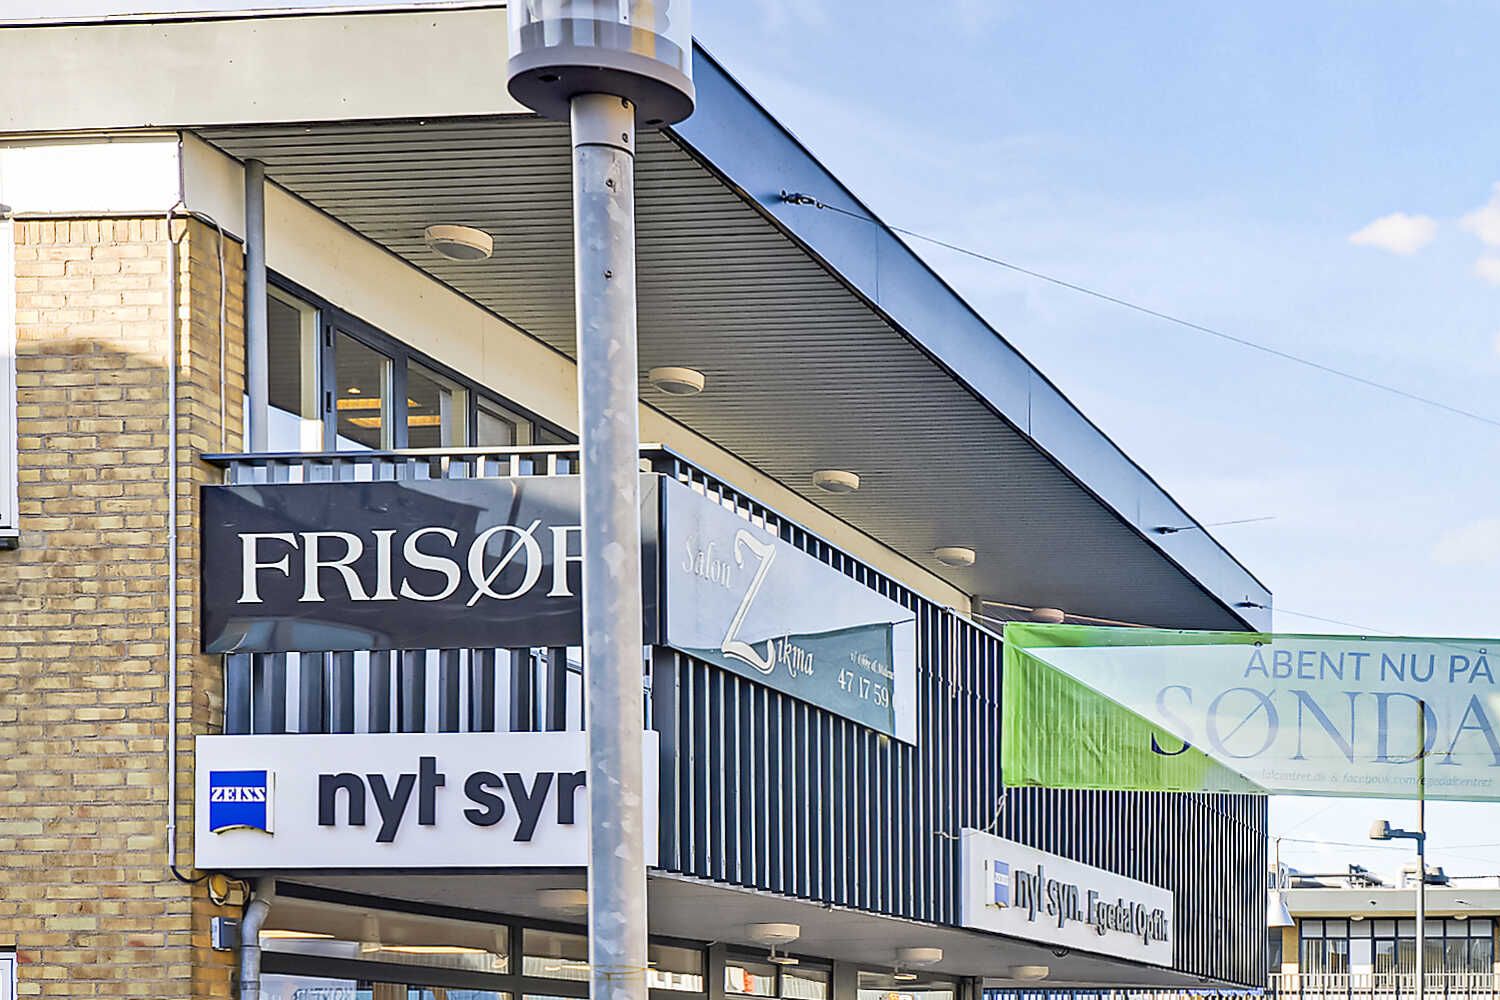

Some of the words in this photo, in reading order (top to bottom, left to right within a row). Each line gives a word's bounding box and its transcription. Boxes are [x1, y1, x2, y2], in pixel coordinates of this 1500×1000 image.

[682, 534, 731, 589] Salon
[837, 667, 854, 692] 47
[858, 676, 870, 700] 17
[874, 682, 889, 709] 59
[1243, 645, 1370, 681] ÅBENT
[1380, 653, 1434, 683] NU
[1449, 648, 1496, 685] PÅ
[210, 786, 266, 803] ZEISS
[318, 755, 446, 843] nyt
[1014, 864, 1044, 922] nyt
[1047, 878, 1084, 929] syn.
[1087, 889, 1134, 936] Egedal
[1135, 902, 1169, 945] Optik
